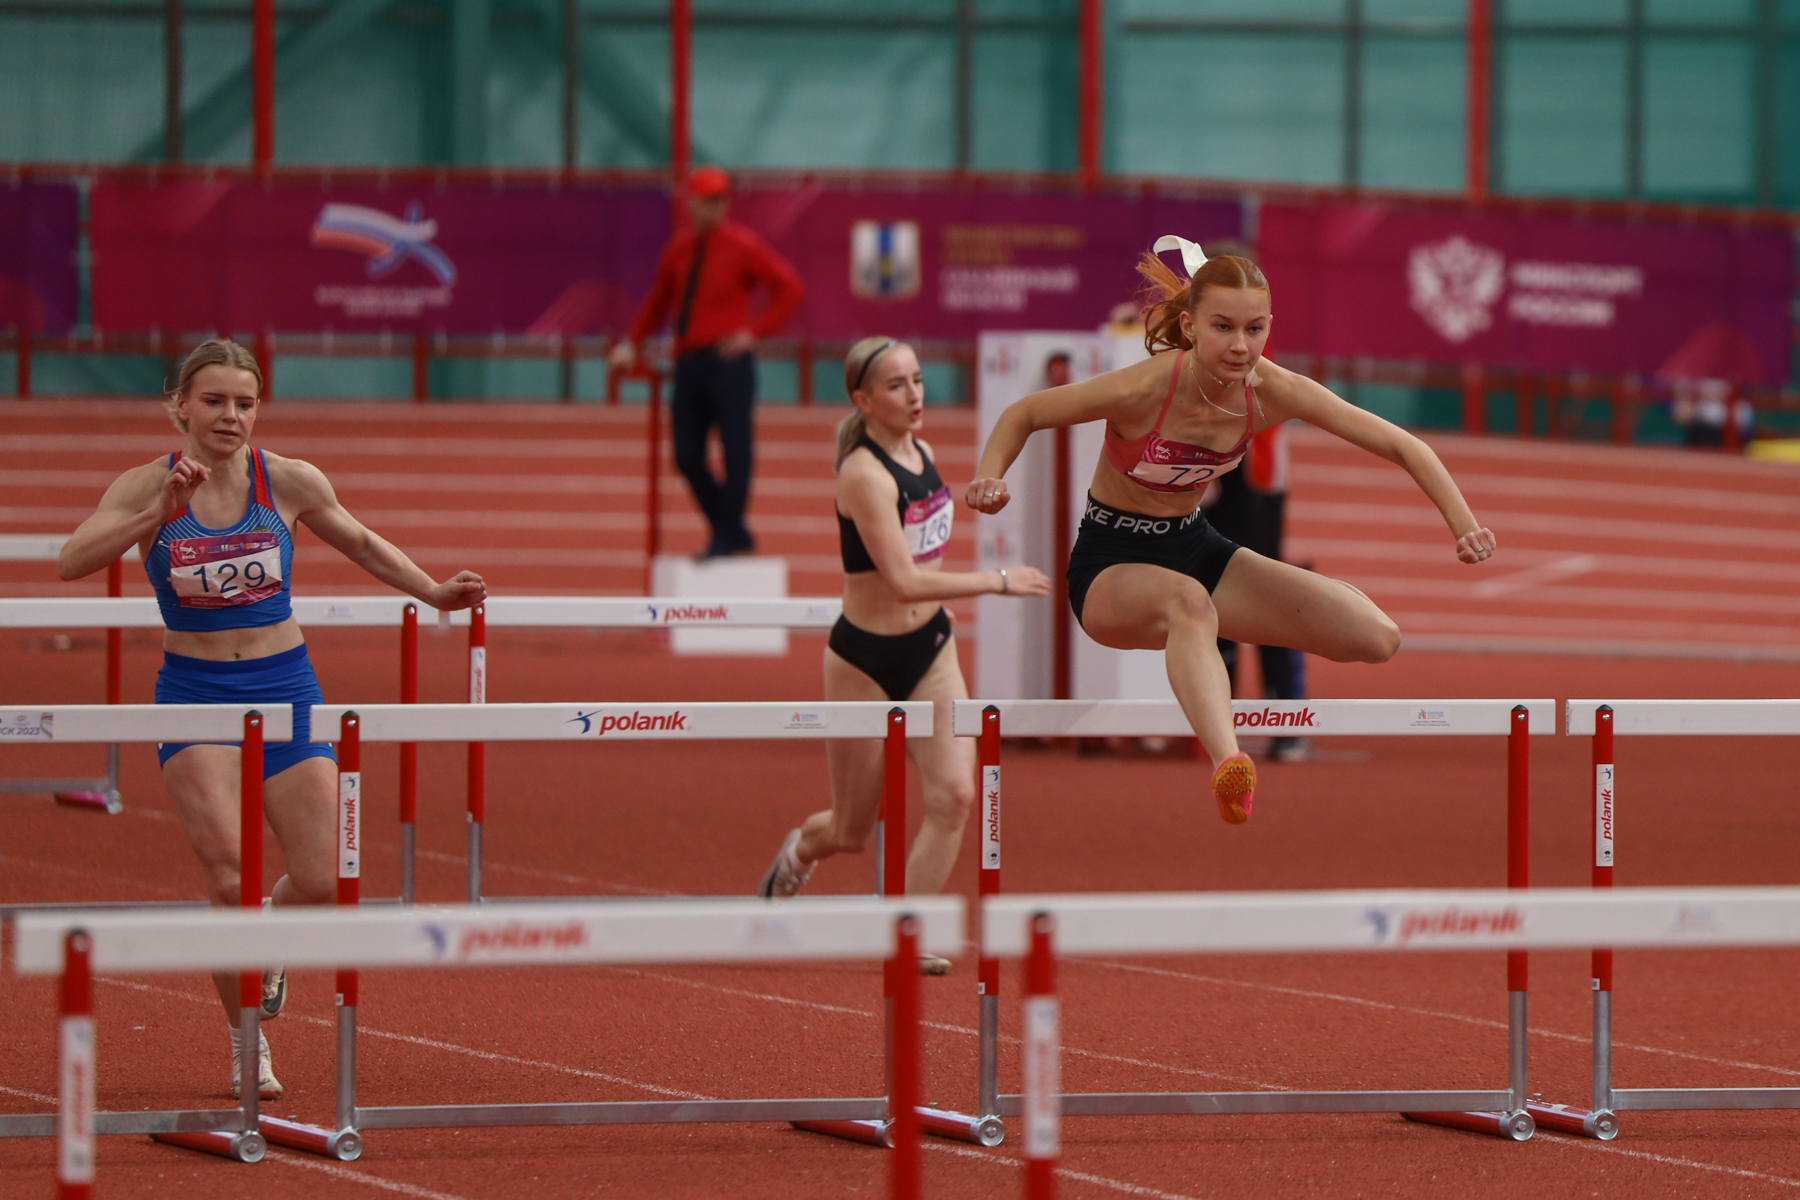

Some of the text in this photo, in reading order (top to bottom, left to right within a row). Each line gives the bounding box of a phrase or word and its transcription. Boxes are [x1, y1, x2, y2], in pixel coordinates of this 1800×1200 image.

[1166, 466, 1214, 485] 72
[920, 512, 949, 550] 126
[1113, 515, 1171, 534] PRO
[193, 561, 266, 594] 129
[664, 603, 729, 623] polanik
[16, 727, 41, 736] 2023
[599, 710, 688, 736] polanik
[1233, 707, 1316, 730] polanik
[343, 797, 357, 851] polanik
[987, 790, 1000, 843] polanik
[1600, 788, 1613, 840] polanik
